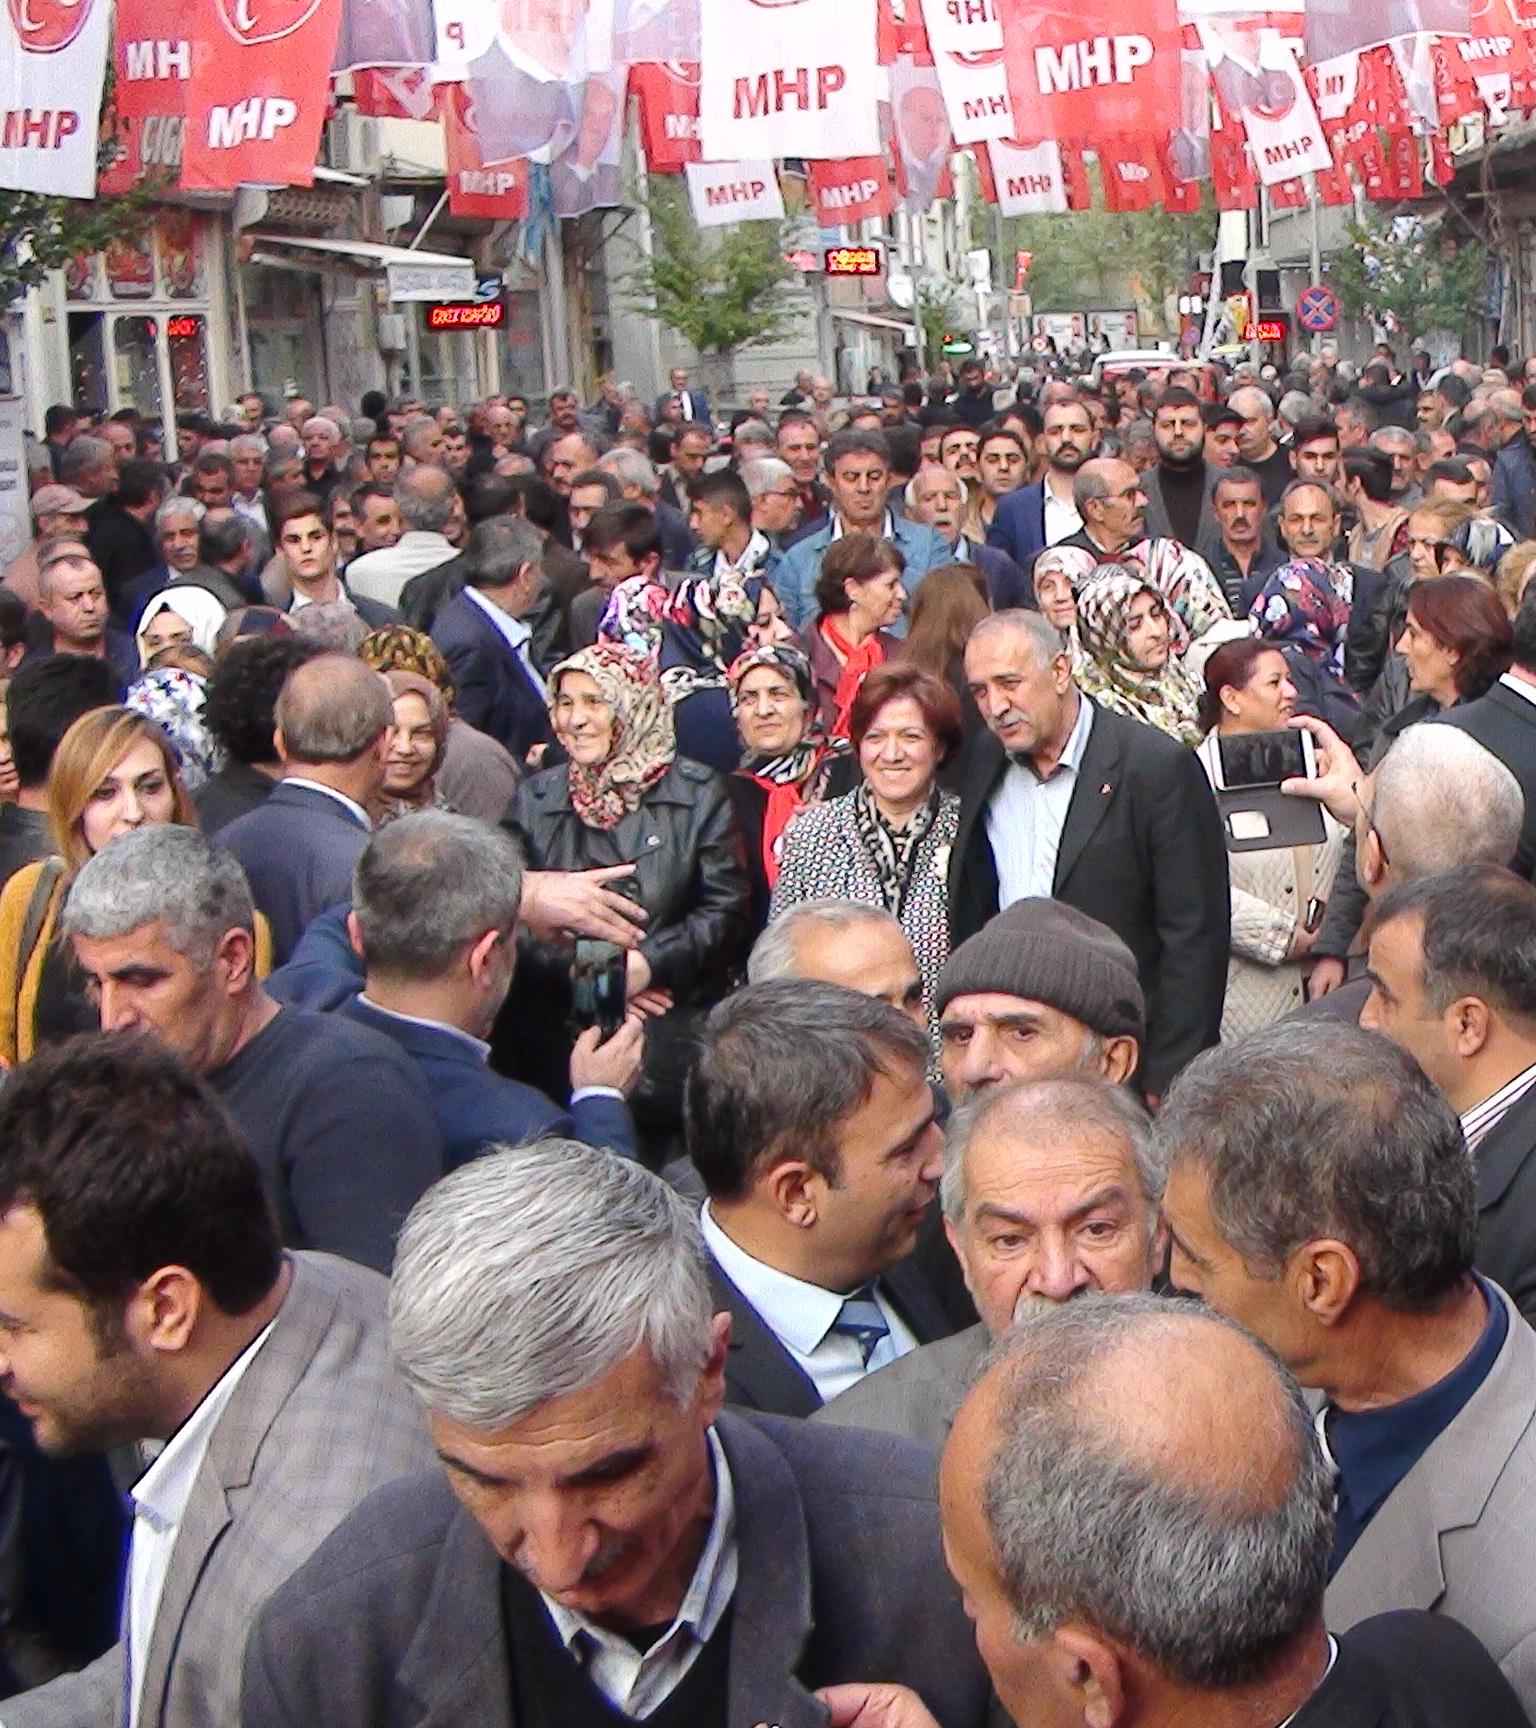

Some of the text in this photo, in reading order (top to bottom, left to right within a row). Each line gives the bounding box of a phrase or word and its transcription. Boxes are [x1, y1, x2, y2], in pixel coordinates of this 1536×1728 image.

[125, 40, 192, 81] MH
[1457, 37, 1513, 61] MHP
[1034, 34, 1154, 94] MHP
[734, 64, 846, 119] MHP
[963, 95, 1008, 120] MH
[206, 96, 299, 149] MHP
[1265, 136, 1313, 165] MHP
[459, 170, 516, 195] MHP
[706, 181, 765, 206] MHP
[819, 179, 880, 209] MHP
